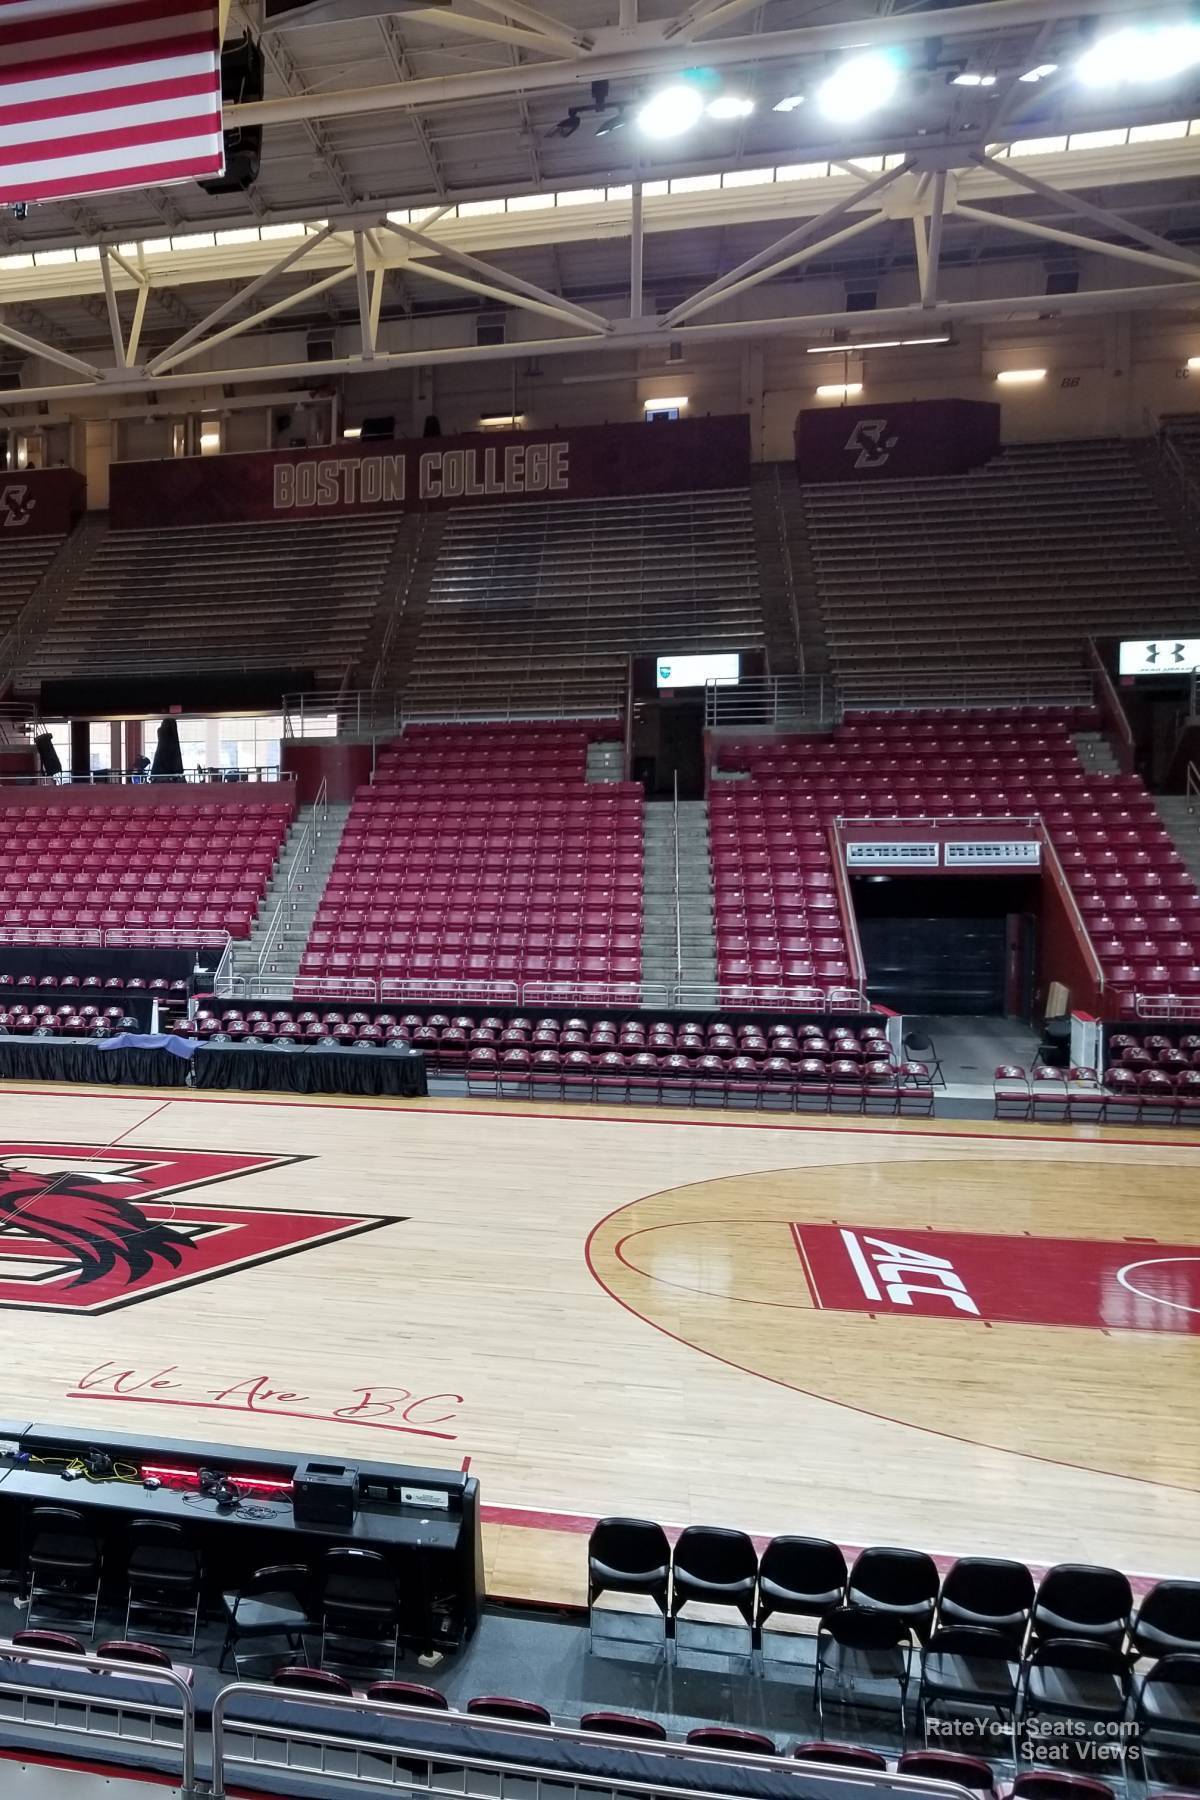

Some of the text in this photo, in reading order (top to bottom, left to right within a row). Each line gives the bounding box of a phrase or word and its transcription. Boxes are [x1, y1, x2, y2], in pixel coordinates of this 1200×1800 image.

[273, 442, 569, 509] BOSTON COLLEGE
[863, 1236, 981, 1315] ACC
[78, 1361, 464, 1424] We Are BC
